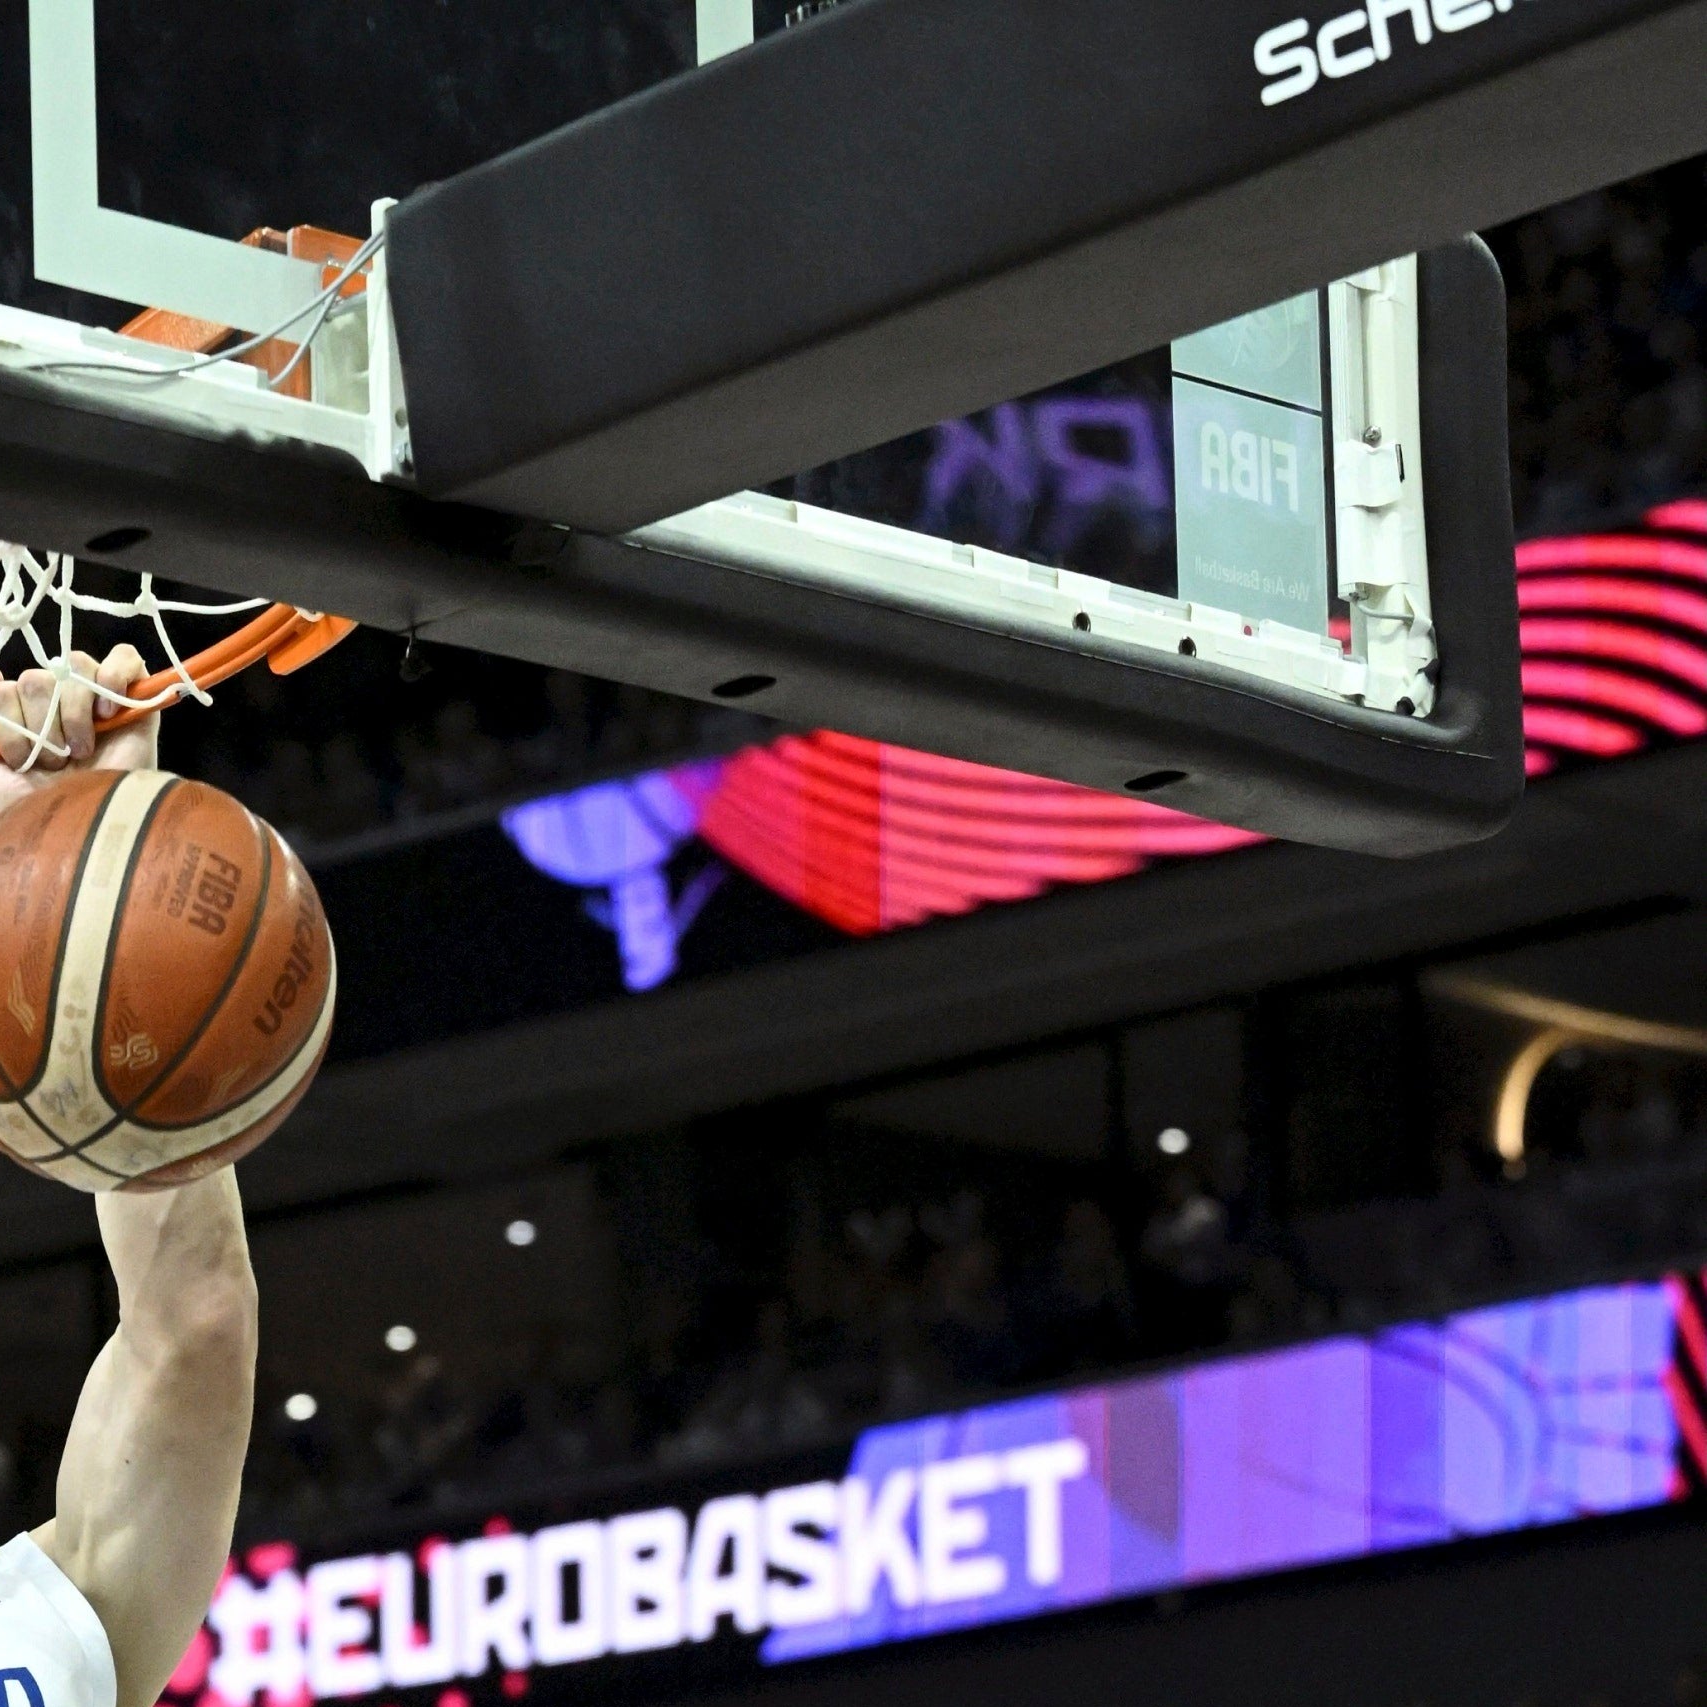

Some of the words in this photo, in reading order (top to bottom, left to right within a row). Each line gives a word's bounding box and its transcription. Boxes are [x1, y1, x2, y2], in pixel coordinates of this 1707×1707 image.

[1254, 0, 1513, 106] Sche
[187, 853, 242, 936] FIBA
[208, 1437, 1090, 1706] #EUROBASKET
